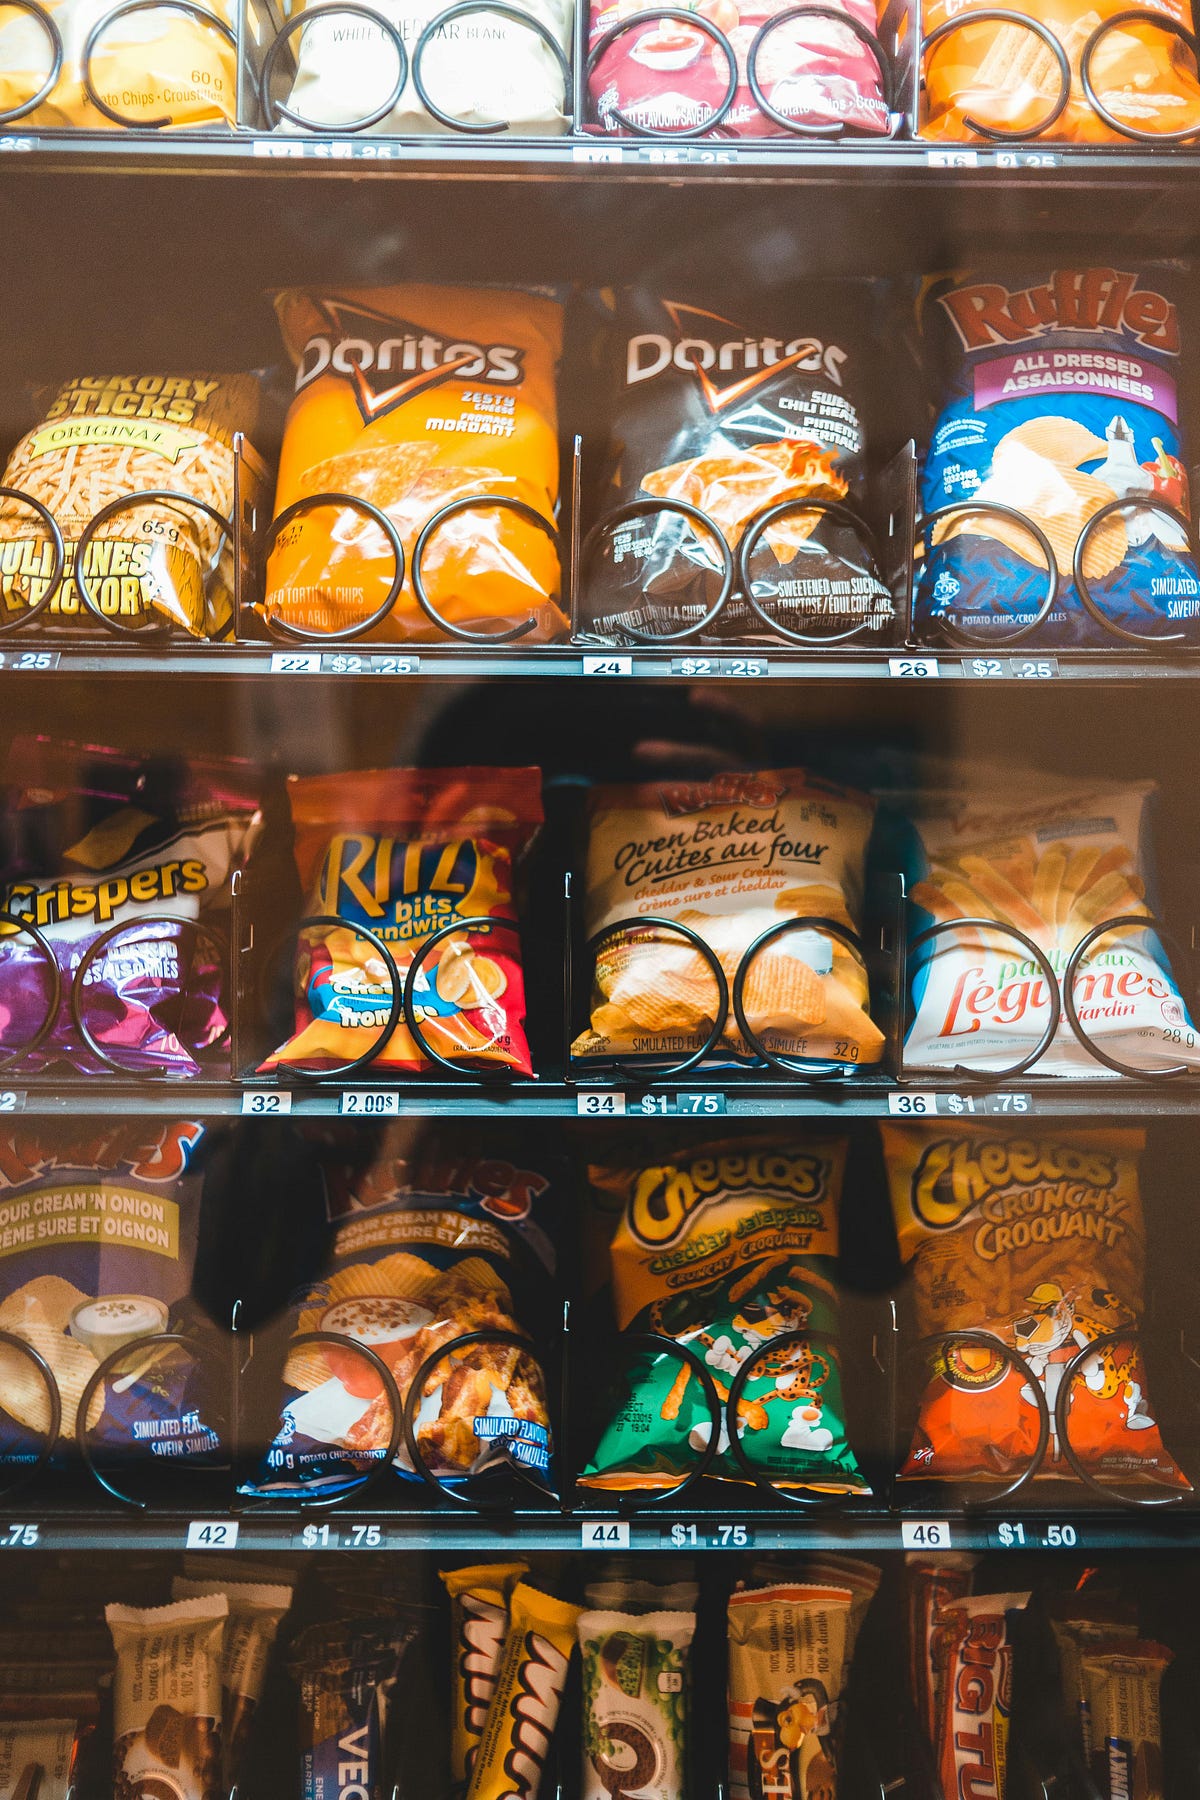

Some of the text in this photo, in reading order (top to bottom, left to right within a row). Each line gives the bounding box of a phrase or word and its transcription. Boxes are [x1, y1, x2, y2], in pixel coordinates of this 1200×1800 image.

[191, 70, 223, 91] 60 g
[122, 90, 154, 107] Chips
[295, 334, 521, 391] Doritos
[626, 334, 848, 387] Doritos
[1013, 354, 1143, 378] ALL DRESSED
[1002, 371, 1154, 401] ASSAISONNÉES
[47, 388, 198, 422] STICKS
[461, 391, 516, 407] ZESTY
[474, 403, 515, 415] CHEESE
[460, 413, 515, 427] FROMAGE
[779, 397, 859, 427] CHILI HEAT
[50, 424, 165, 446] ORIGINAL
[425, 418, 516, 437] MORDANT
[803, 416, 859, 441] PIMENT
[142, 520, 165, 535] 65
[169, 528, 180, 543] g
[336, 586, 364, 604] CHIPS
[778, 578, 831, 597] SWEETENED
[1151, 577, 1198, 596] SIMULATED
[682, 604, 707, 620] CHIPS
[1167, 600, 1200, 618] SAVEUR
[962, 615, 991, 625] POTATO
[12, 654, 51, 669] .25
[280, 658, 310, 672] 22
[331, 654, 412, 673] $2 .25
[592, 662, 621, 675] 24
[681, 658, 761, 676] $2 .25
[900, 662, 928, 677] 26
[972, 658, 1052, 678] $2 .25
[614, 831, 691, 871] Oven
[692, 810, 784, 843] Baked
[625, 834, 829, 887] Cuites au four
[324, 833, 474, 918] RITZ
[693, 877, 705, 887] &
[742, 868, 787, 879] Cream
[2, 860, 208, 923] Crispers
[638, 878, 787, 913] Crème sure et cheddar
[395, 894, 453, 924] bits
[631, 931, 655, 945] GRAS
[1096, 952, 1138, 969] aux
[72, 956, 179, 986] SSAISONNÉS
[1162, 1028, 1195, 1048] 28 g
[632, 1036, 859, 1061] SIMULATED SIMULÉE 32 g
[251, 1095, 280, 1113] 32
[347, 1094, 394, 1114] 2.00$
[586, 1096, 615, 1113] 34
[641, 1094, 718, 1114] $1 .75
[898, 1096, 927, 1113] 36
[948, 1094, 1028, 1114] $1 .75
[916, 1140, 1114, 1226] Cheetos
[33, 1193, 87, 1213] CREAM
[110, 1196, 164, 1223] ONION
[980, 1182, 1130, 1224] CRUNCHY
[382, 1212, 440, 1226] CREAM
[38, 1216, 169, 1248] SURE ET OIGNON
[391, 1225, 434, 1239] SURE
[436, 1228, 457, 1242] ET
[974, 1211, 1125, 1261] CROQUANT
[740, 1232, 813, 1260] CROQUANT
[133, 1419, 180, 1439] SIMULATED
[474, 1417, 520, 1436] SIMULATED
[151, 1440, 184, 1457] SAVEUR
[267, 1449, 328, 1469] 40 g POTATO
[1, 1525, 39, 1546] .75
[198, 1525, 228, 1545] 42
[302, 1524, 381, 1547] $1 .75
[592, 1525, 621, 1542] 44
[671, 1523, 748, 1547] $1 .75
[913, 1525, 941, 1545] 46
[998, 1522, 1077, 1547] $1 .50
[783, 1609, 796, 1674] sourced cocoa
[816, 1610, 829, 1673] 100 % durable
[770, 1654, 780, 1673] 100%
[804, 1654, 814, 1675] Cacao
[955, 1614, 1007, 1715] BIG
[304, 1754, 313, 1793] BARRE
[759, 1748, 793, 1800] ES
